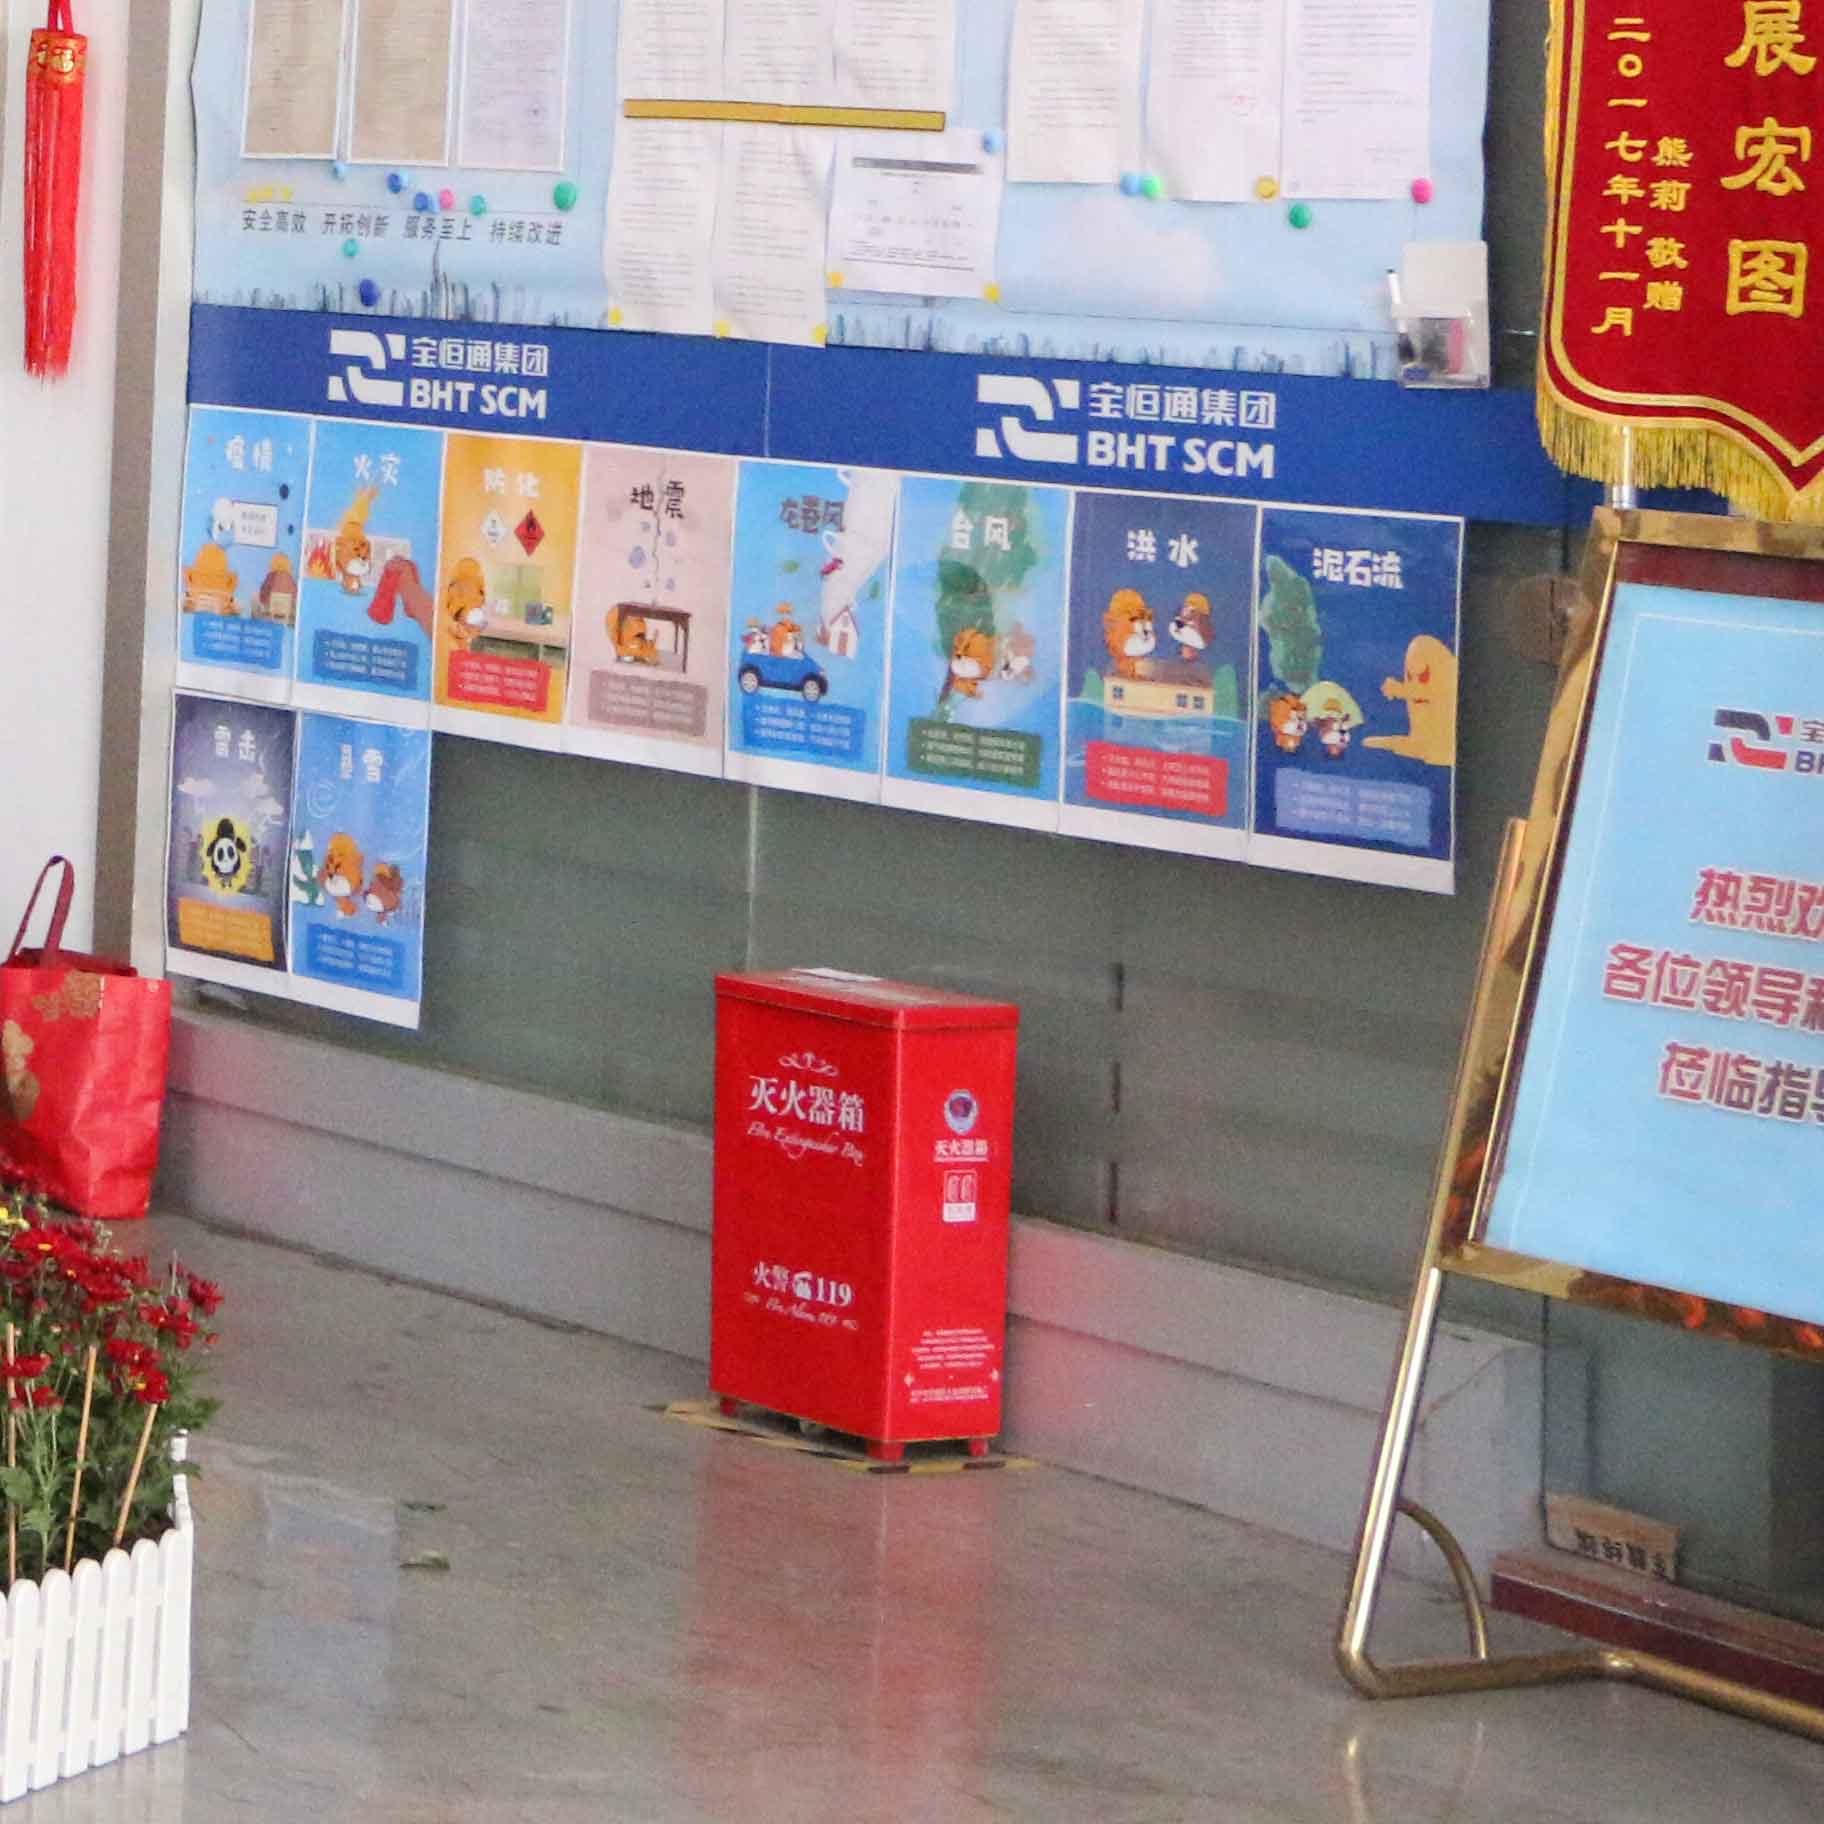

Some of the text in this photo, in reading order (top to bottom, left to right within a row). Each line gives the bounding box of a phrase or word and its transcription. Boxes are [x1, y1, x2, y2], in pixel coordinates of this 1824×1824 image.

[241, 208, 307, 234] 安全高效
[320, 212, 390, 239] 开拓创新
[488, 220, 564, 246] 持续改进
[411, 335, 550, 377] 宝恒通集团
[409, 377, 548, 420] BHT SCM
[1088, 381, 1277, 430] 宝恒通集团
[353, 451, 401, 486] 火灾
[1087, 430, 1275, 479] BHT SCM
[629, 480, 686, 519] 地震
[949, 514, 1012, 553] 台风
[1126, 529, 1200, 569] 洪水
[1311, 547, 1404, 589] 泥石流
[1659, 1042, 1824, 1122] 莅临指
[748, 1075, 865, 1133] 灭火器箱
[753, 1261, 853, 1307] 火警 119
